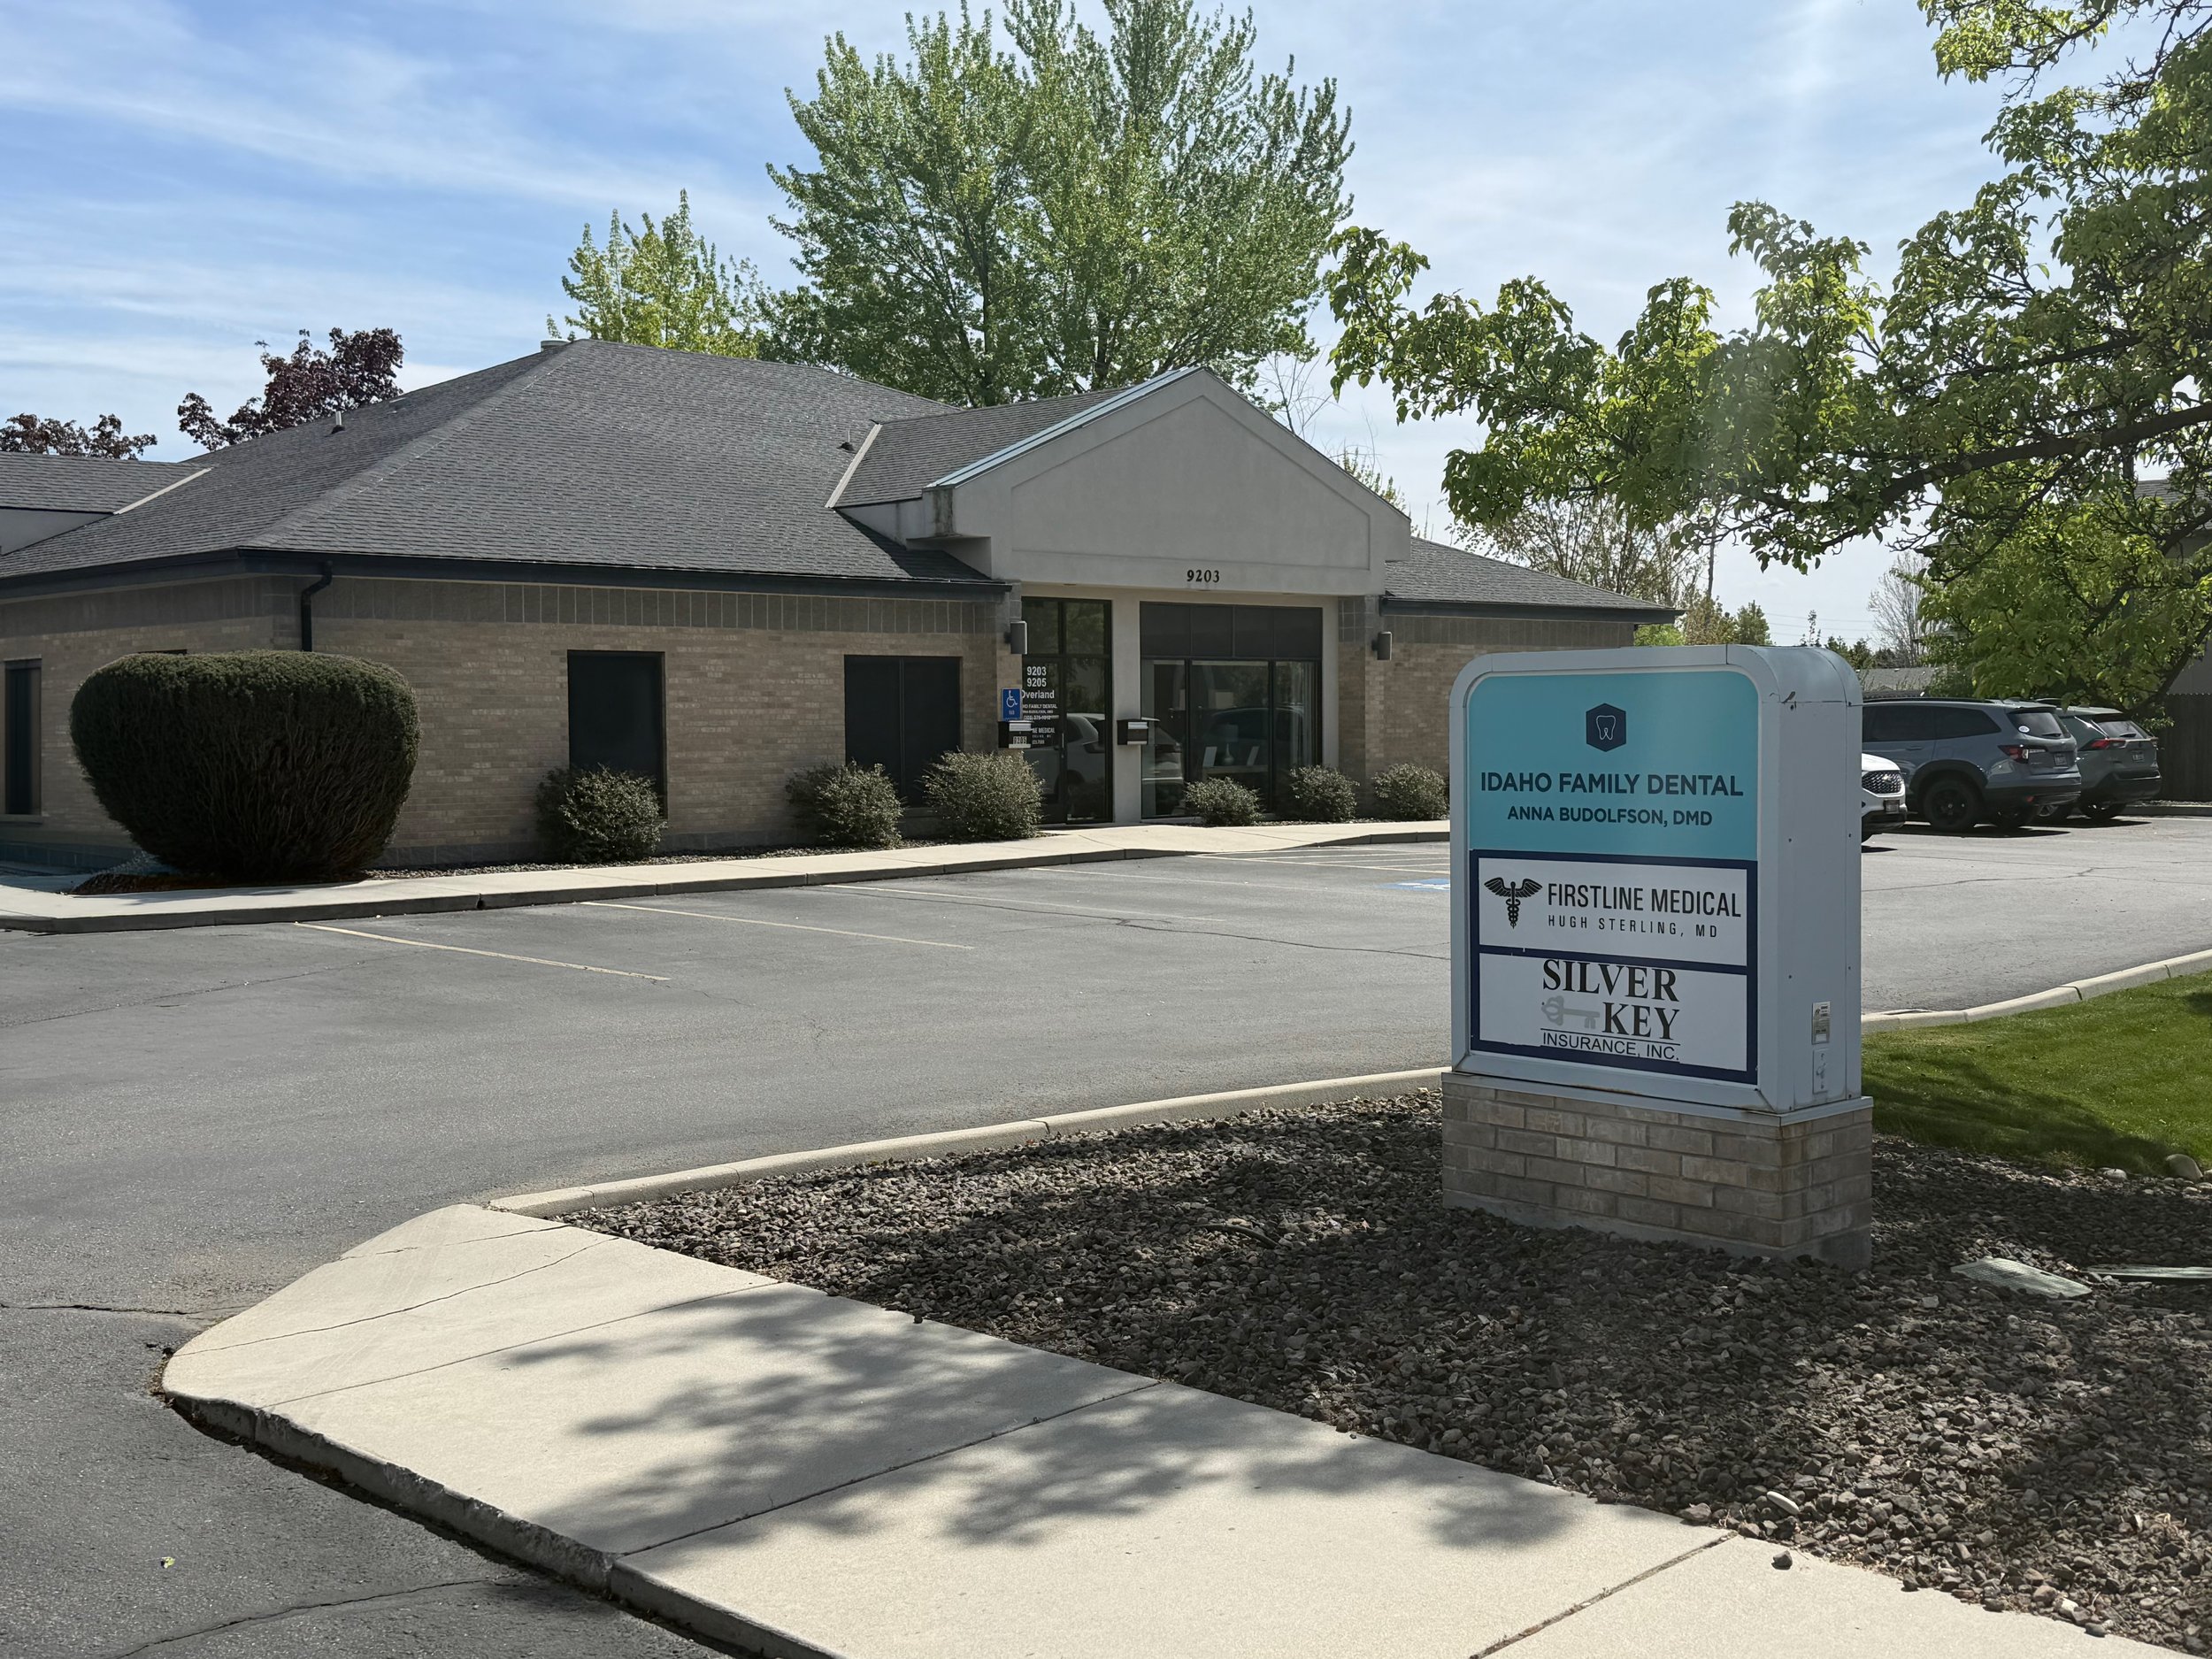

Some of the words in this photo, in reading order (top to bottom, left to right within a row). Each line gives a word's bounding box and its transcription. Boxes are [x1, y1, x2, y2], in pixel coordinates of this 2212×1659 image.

[1187, 569, 1220, 583] 9203
[1026, 665, 1047, 676] 9203
[1026, 677, 1047, 687] 9205
[1021, 689, 1055, 699] Overland
[1481, 772, 1551, 792] IDAHO
[1559, 773, 1640, 794] FAMILY
[1647, 774, 1743, 796] DENTAL
[1507, 806, 1555, 821] ANNA
[1559, 807, 1668, 827] BUDOLFSON,
[1673, 810, 1713, 826] DMD
[1548, 883, 1643, 911] FIRSTLINE
[1651, 888, 1741, 918] MEDICAL
[1548, 915, 1587, 929] HUGH
[1598, 918, 1684, 937] STERLING,
[1695, 924, 1717, 938] MD
[1542, 958, 1679, 1002] SILVER
[1601, 1002, 1679, 1040] KEY
[1542, 1032, 1640, 1057] INSURANCE,
[1647, 1044, 1679, 1060] INC.
